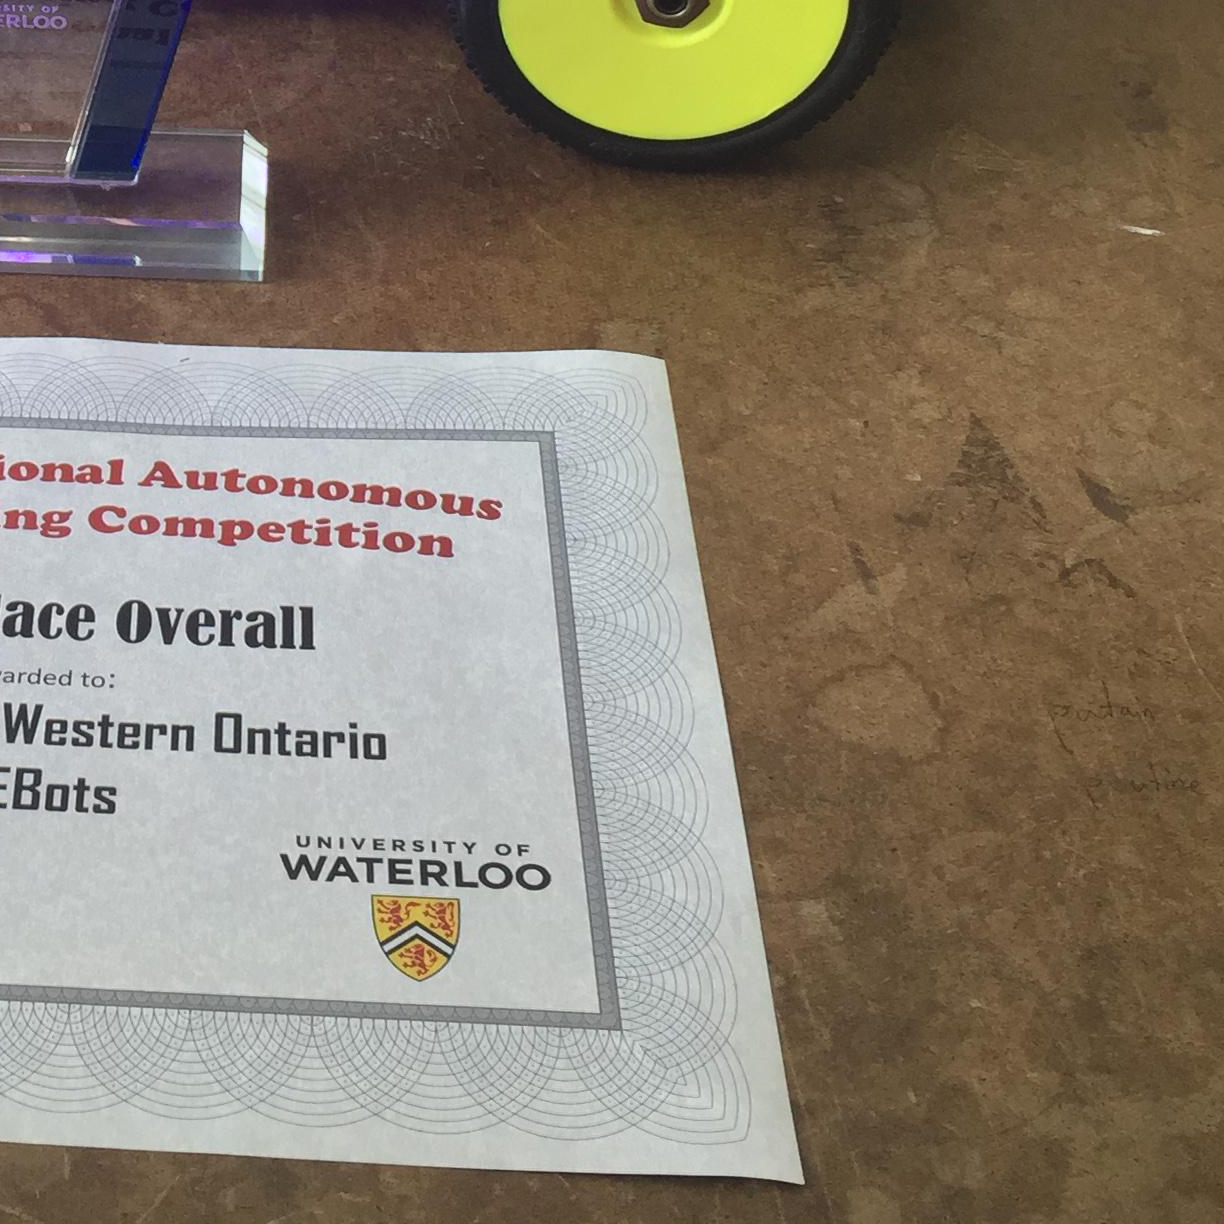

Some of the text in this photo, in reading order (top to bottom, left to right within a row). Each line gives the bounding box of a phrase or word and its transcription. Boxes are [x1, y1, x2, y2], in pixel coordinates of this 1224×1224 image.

[41, 4, 60, 14] OF
[137, 459, 504, 521] Autonomous
[87, 504, 456, 558] Competition
[115, 598, 317, 651] Overall
[80, 671, 117, 690] to:
[4, 701, 196, 752] Western
[213, 711, 388, 761] Ontario
[295, 834, 531, 857] UNIVERSITY OF
[279, 853, 553, 891] WATERLOO
